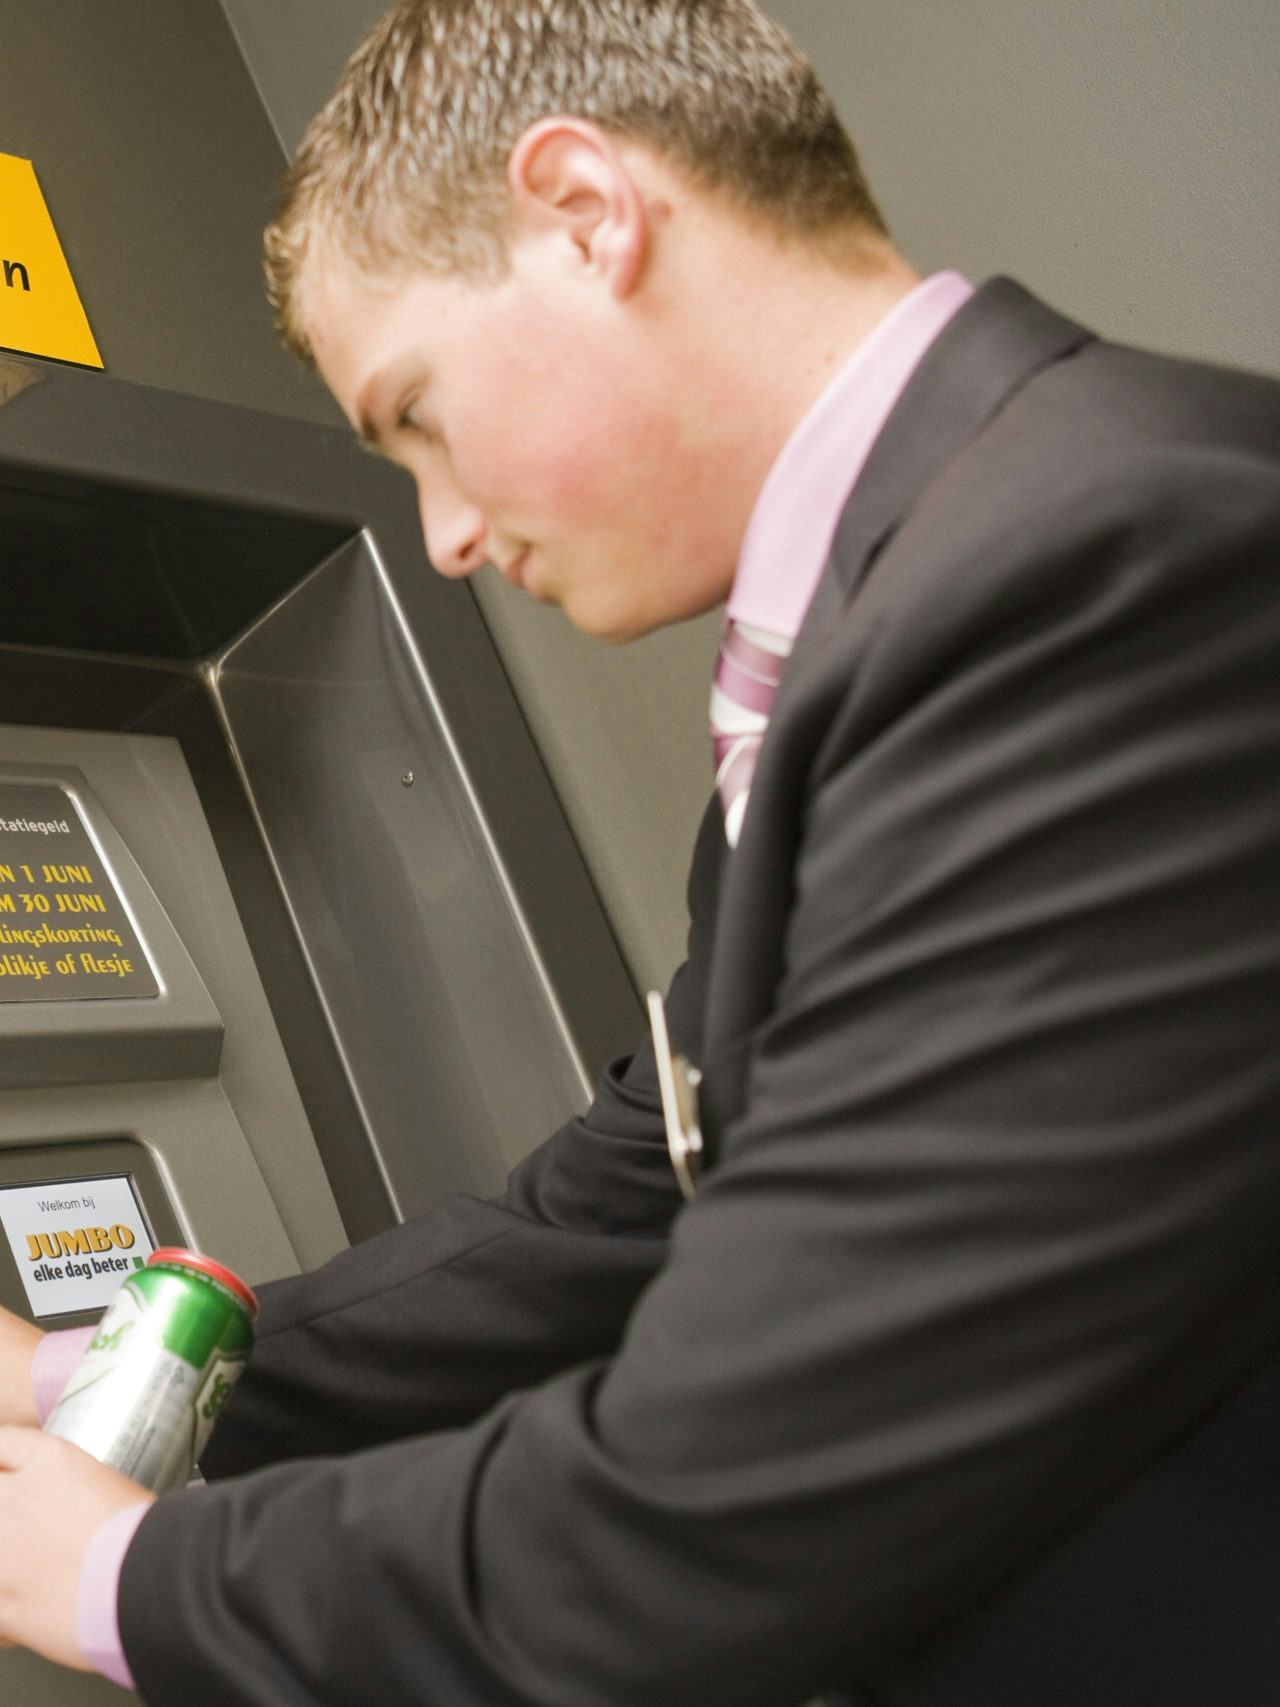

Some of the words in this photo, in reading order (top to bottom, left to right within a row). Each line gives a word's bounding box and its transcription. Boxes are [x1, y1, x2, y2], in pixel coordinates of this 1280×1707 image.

[21, 863, 35, 883] 1
[44, 865, 93, 884] JUNI
[19, 893, 50, 914] 30
[58, 894, 107, 913] JUNI
[55, 953, 76, 976] of
[38, 1198, 80, 1213] Welkom
[82, 1196, 96, 1210] bij
[25, 1223, 136, 1262] JUMBO
[33, 1263, 64, 1283] elke
[65, 1259, 92, 1280] dag
[93, 1254, 129, 1275] beter
